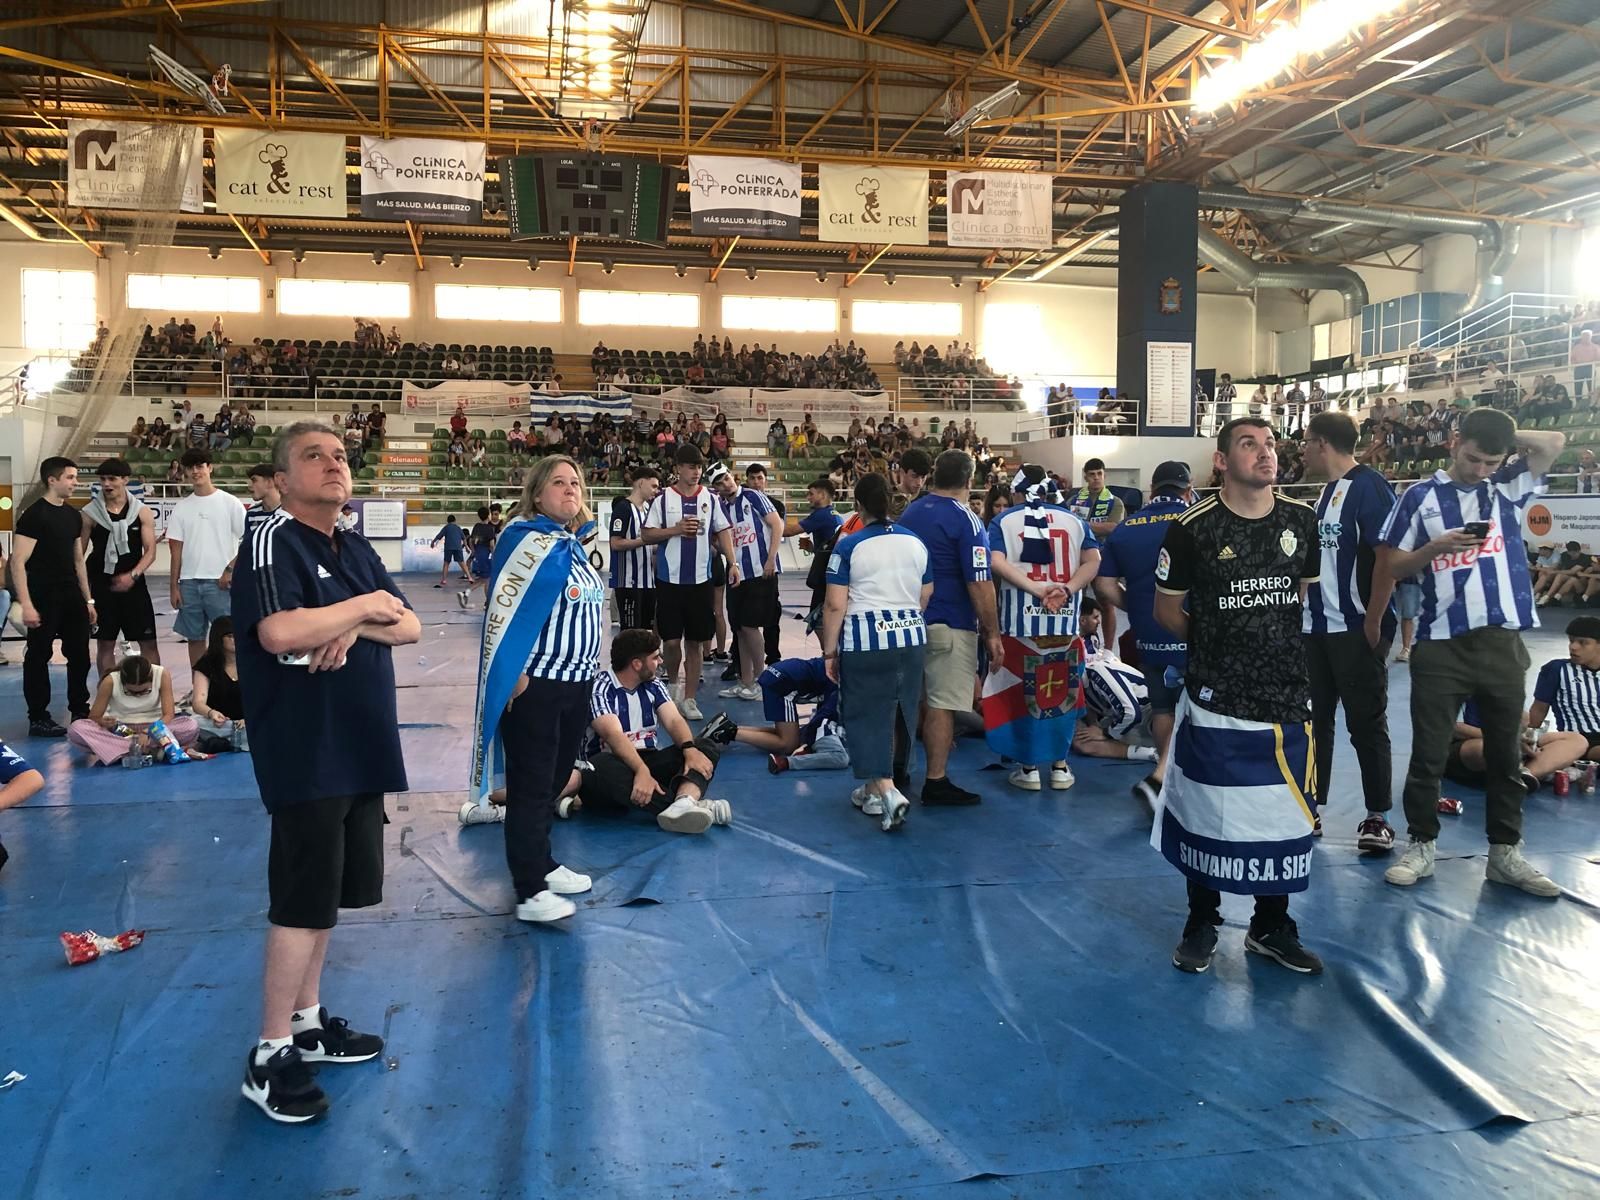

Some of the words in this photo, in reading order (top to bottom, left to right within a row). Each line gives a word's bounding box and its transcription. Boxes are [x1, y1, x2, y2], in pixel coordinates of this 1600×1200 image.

[396, 168, 483, 182] PONFERRADA
[229, 181, 258, 195] cat
[299, 184, 334, 199] rest
[721, 185, 799, 199] PONFERRADA
[987, 189, 1018, 199] Esthetic
[424, 202, 441, 210] MÁS
[443, 203, 471, 212] BIERZO
[987, 198, 1011, 207] Dental
[986, 207, 1023, 217] Academy
[703, 216, 719, 224] MÁS
[720, 217, 745, 225] SALUD.
[746, 217, 762, 225] MÁS
[762, 219, 787, 227] BIERZO
[829, 211, 855, 225] cat
[888, 215, 917, 228] rest
[1004, 223, 1048, 235] Dental
[1529, 515, 1549, 525] HJM
[1553, 514, 1578, 522] Hispano
[496, 572, 526, 608] CON
[516, 550, 539, 571] LA
[1230, 575, 1292, 593] HERRERO
[1179, 840, 1245, 882] SILVANO
[1247, 857, 1279, 882] S.A.
